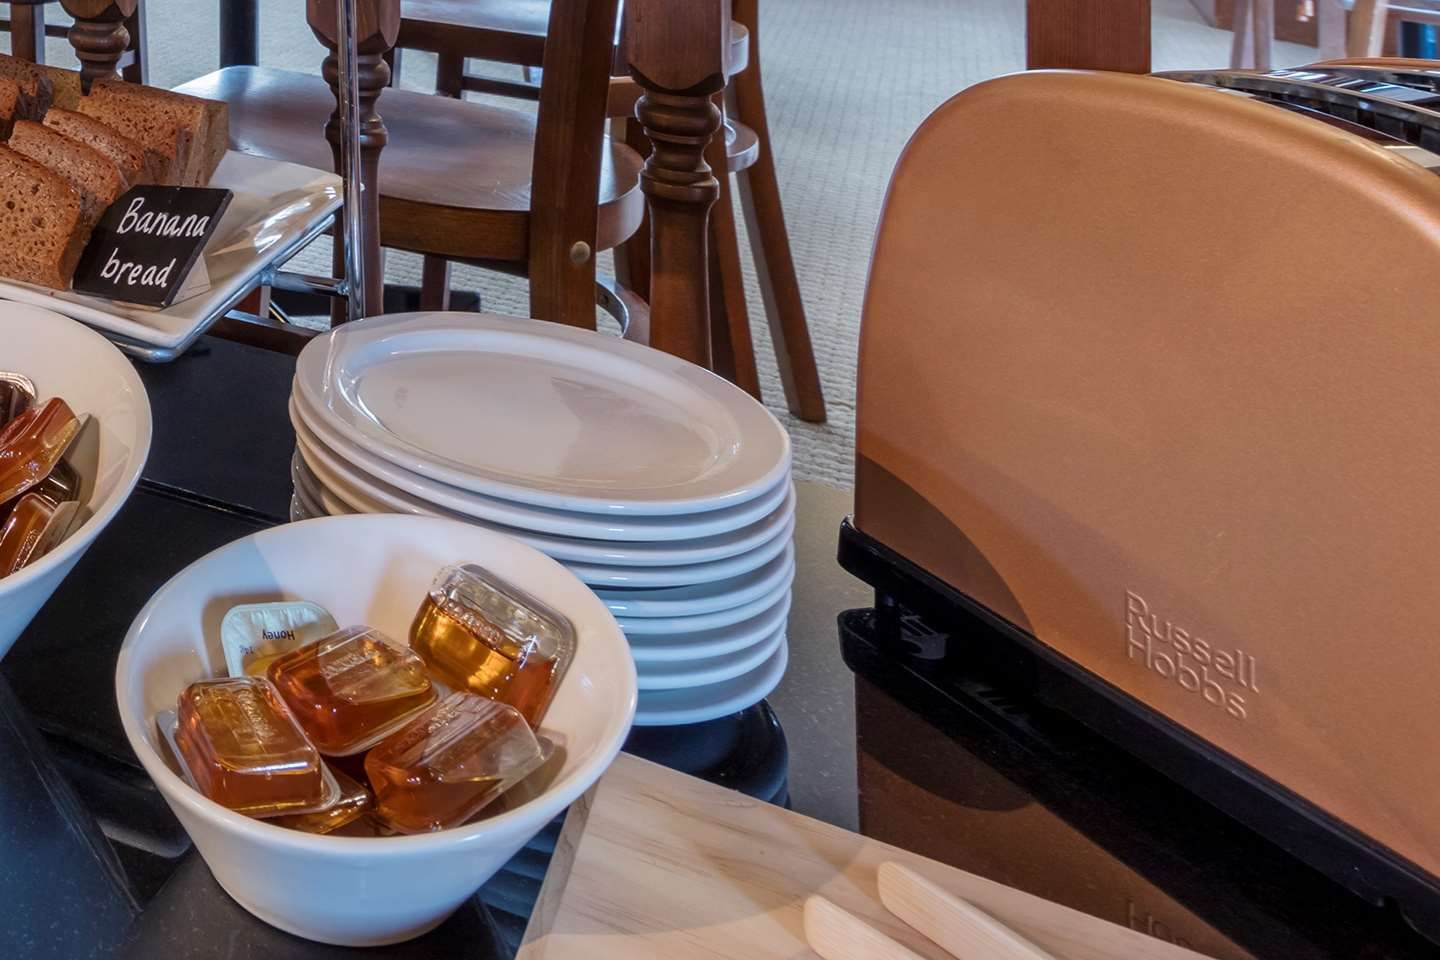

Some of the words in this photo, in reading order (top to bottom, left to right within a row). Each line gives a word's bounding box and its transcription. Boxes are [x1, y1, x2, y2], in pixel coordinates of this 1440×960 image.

[116, 197, 210, 238] Banana
[100, 247, 177, 288] bread
[262, 629, 296, 641] Honey
[1126, 589, 1260, 694] Russell
[1126, 624, 1248, 719] Hobbs
